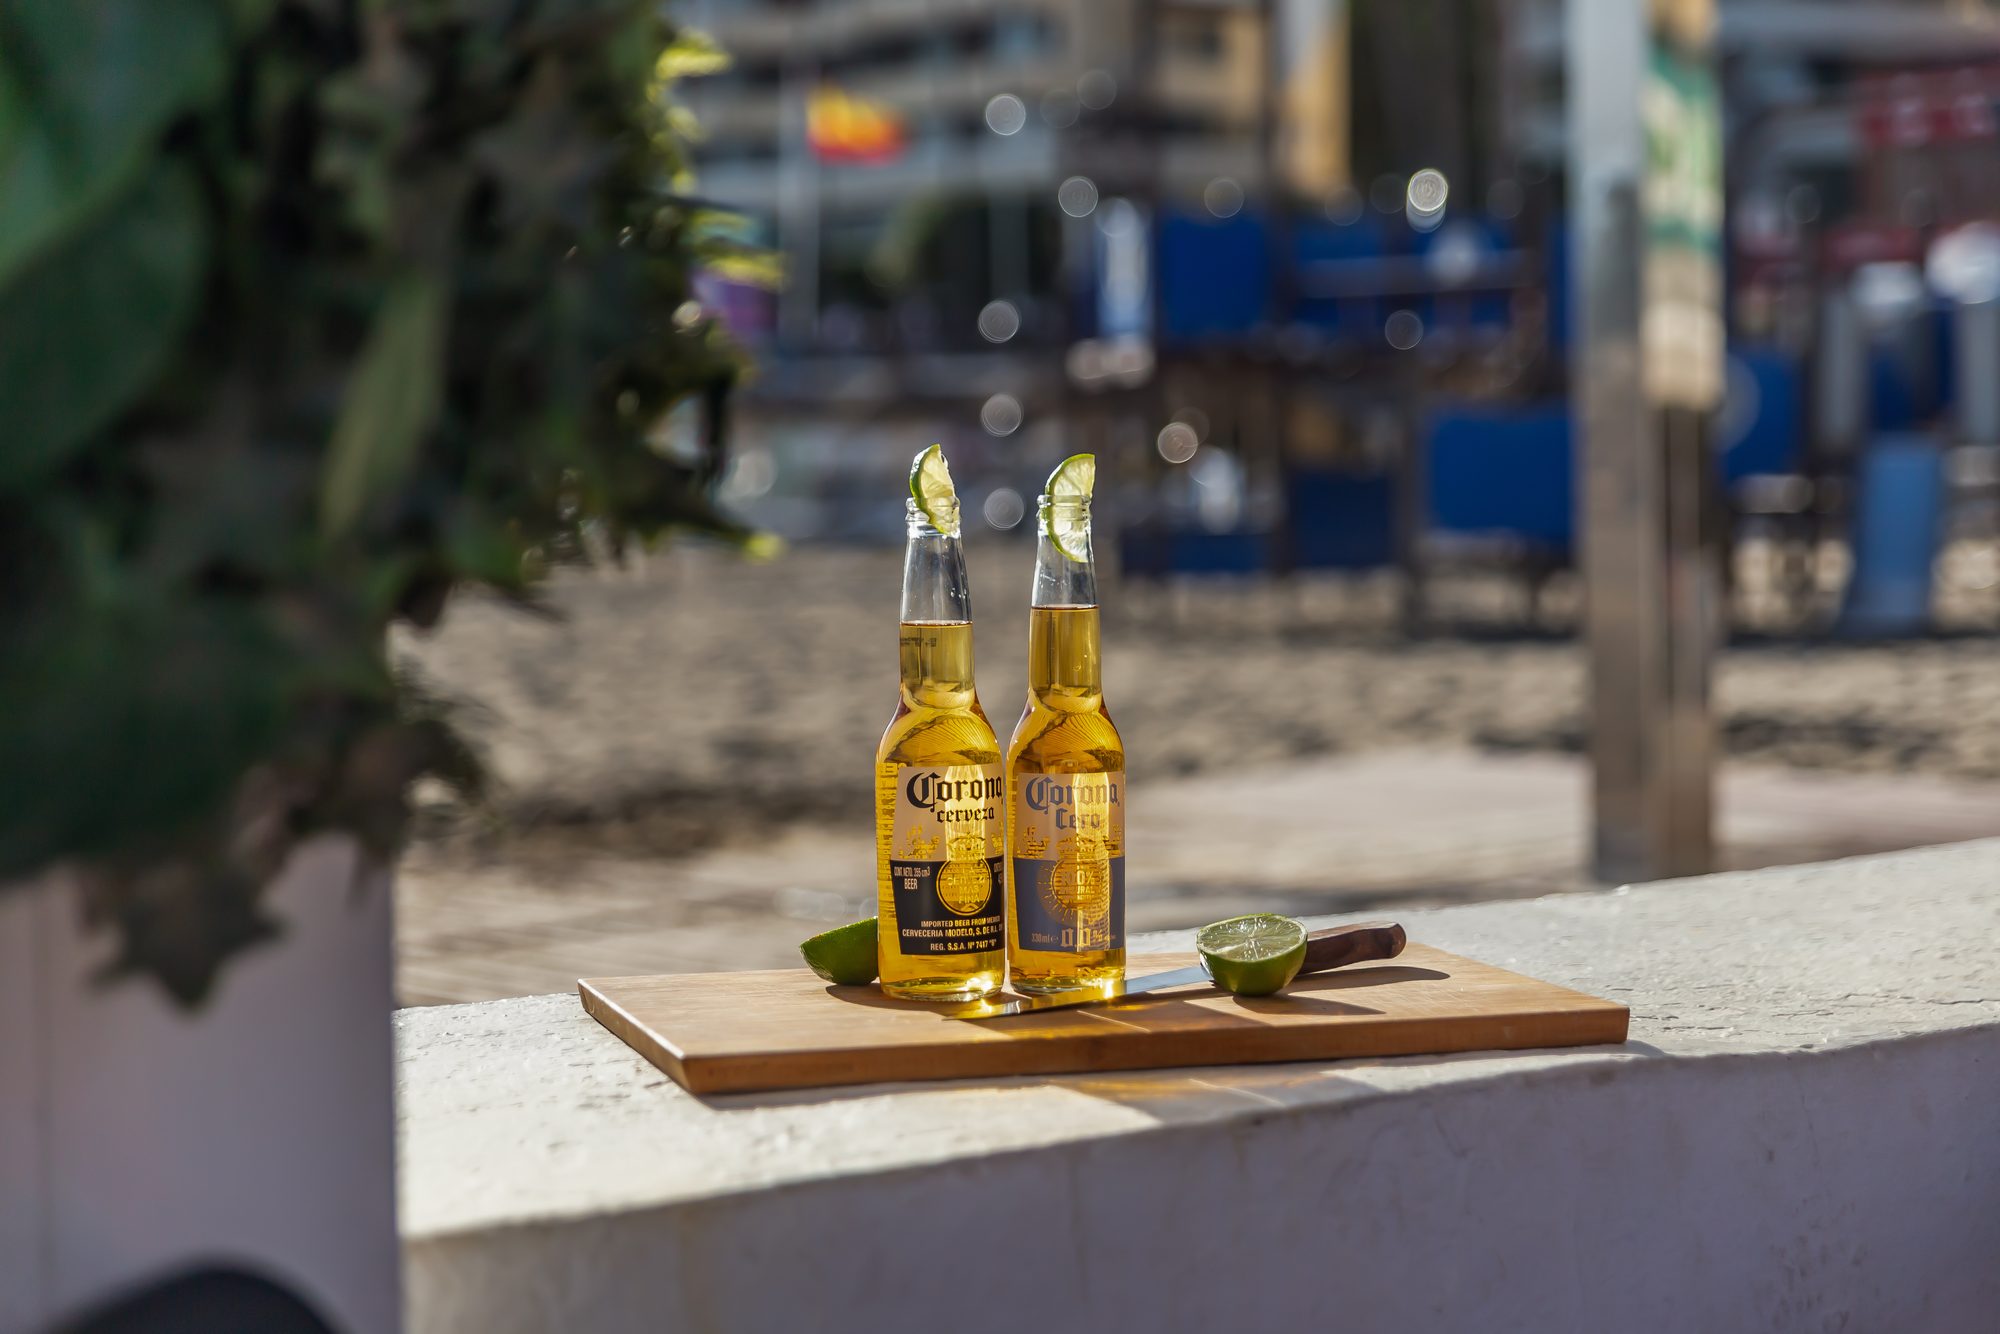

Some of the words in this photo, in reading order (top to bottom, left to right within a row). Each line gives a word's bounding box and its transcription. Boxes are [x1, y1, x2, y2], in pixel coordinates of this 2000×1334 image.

[906, 771, 1003, 813] Corona
[1026, 777, 1120, 814] Corona
[937, 807, 995, 823] cerveza
[1056, 808, 1100, 830] Cero
[904, 878, 918, 890] BEER
[971, 918, 986, 926] FROM
[902, 929, 943, 937] CERVECERIA
[945, 928, 975, 937] MODELO,
[976, 927, 982, 935] S.
[983, 926, 990, 935] DE
[947, 942, 966, 950] S.S.A.
